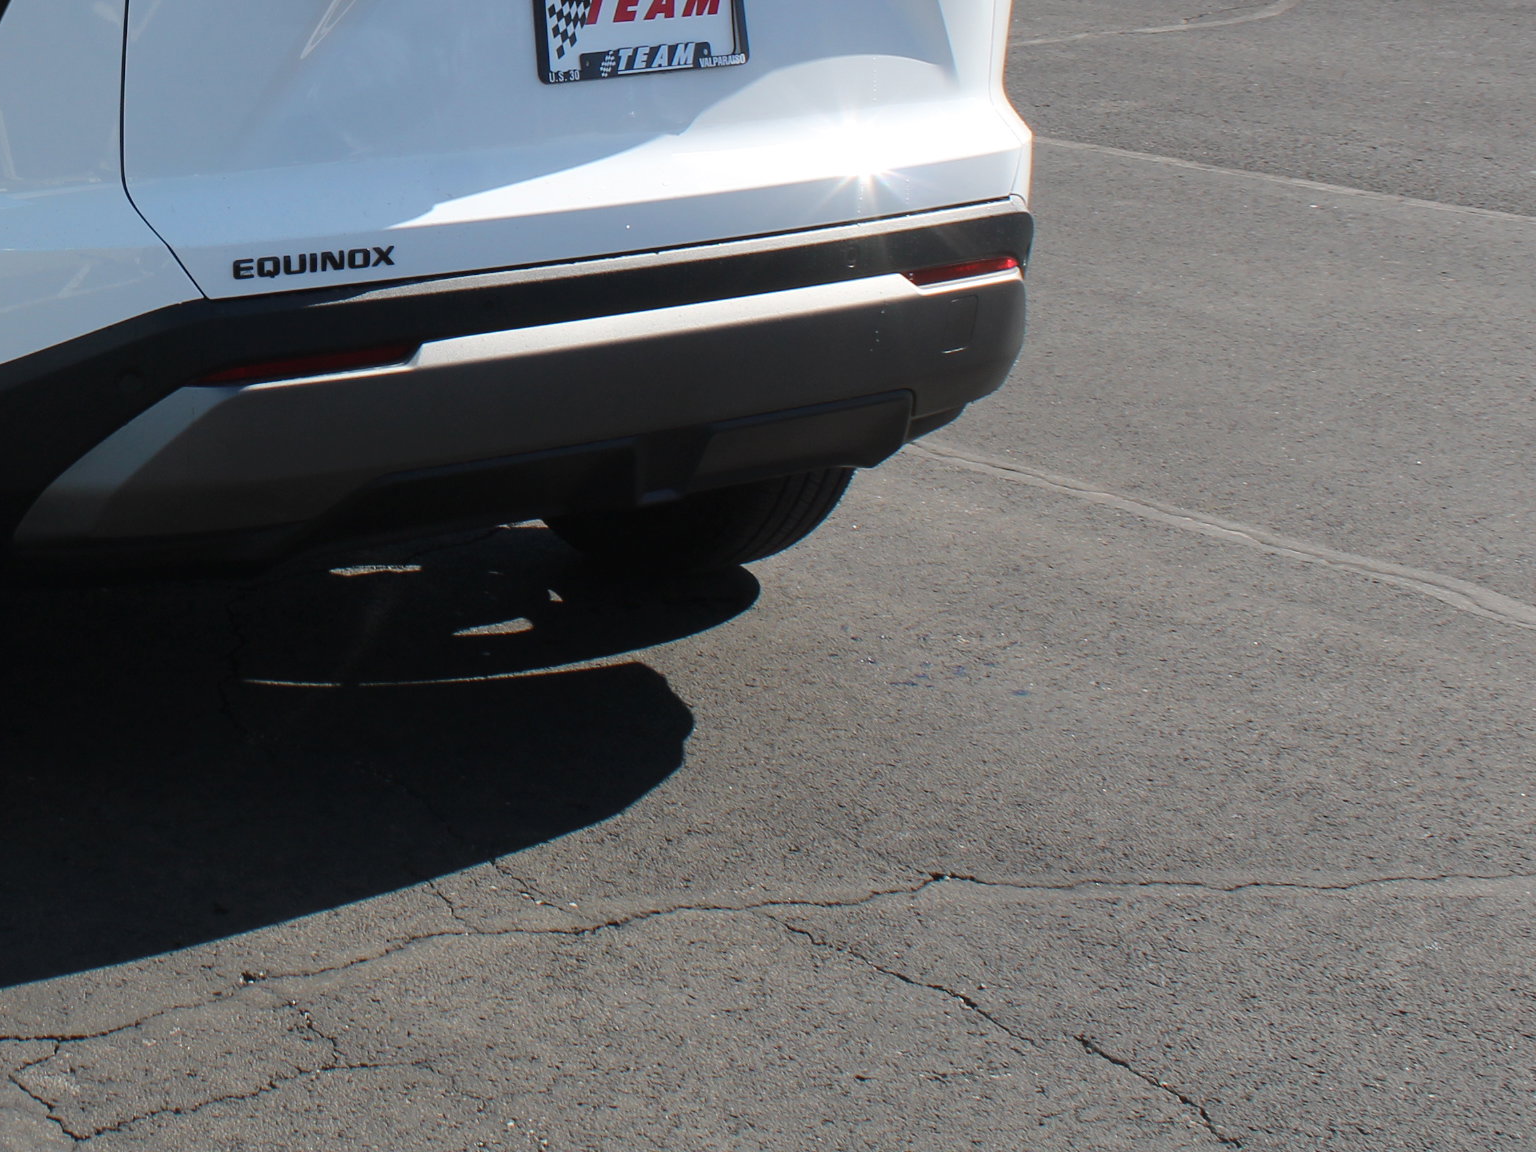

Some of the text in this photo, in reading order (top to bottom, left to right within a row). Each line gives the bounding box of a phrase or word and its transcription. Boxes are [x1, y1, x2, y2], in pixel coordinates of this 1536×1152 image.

[618, 42, 696, 70] TEAM
[698, 53, 746, 69] VALPARAISO
[548, 70, 581, 83] U.S. 30
[231, 245, 396, 280] EQUINOX
